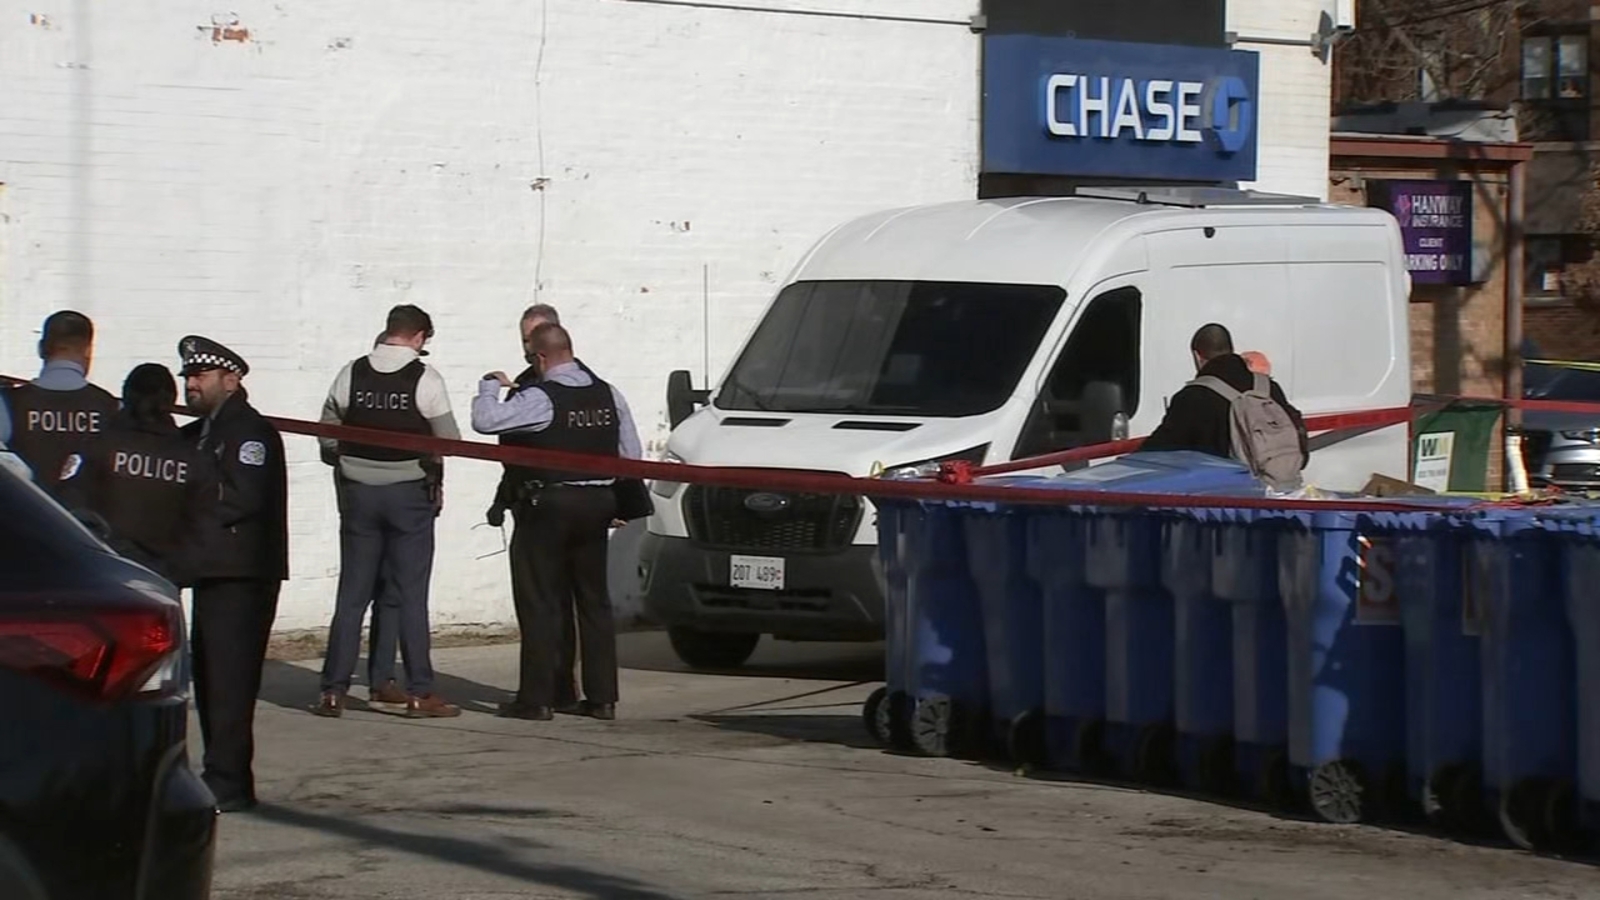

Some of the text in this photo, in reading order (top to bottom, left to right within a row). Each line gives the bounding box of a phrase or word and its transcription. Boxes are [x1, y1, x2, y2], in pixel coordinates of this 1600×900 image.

[1046, 73, 1203, 142] CHASE
[1412, 195, 1464, 214] HANWAY
[1412, 215, 1464, 227] INSURANCE
[1403, 254, 1437, 271] ARKING
[355, 391, 410, 411] POLICE
[27, 410, 101, 432] POLICE
[567, 408, 612, 428] POLICE
[113, 451, 189, 483] POLICE
